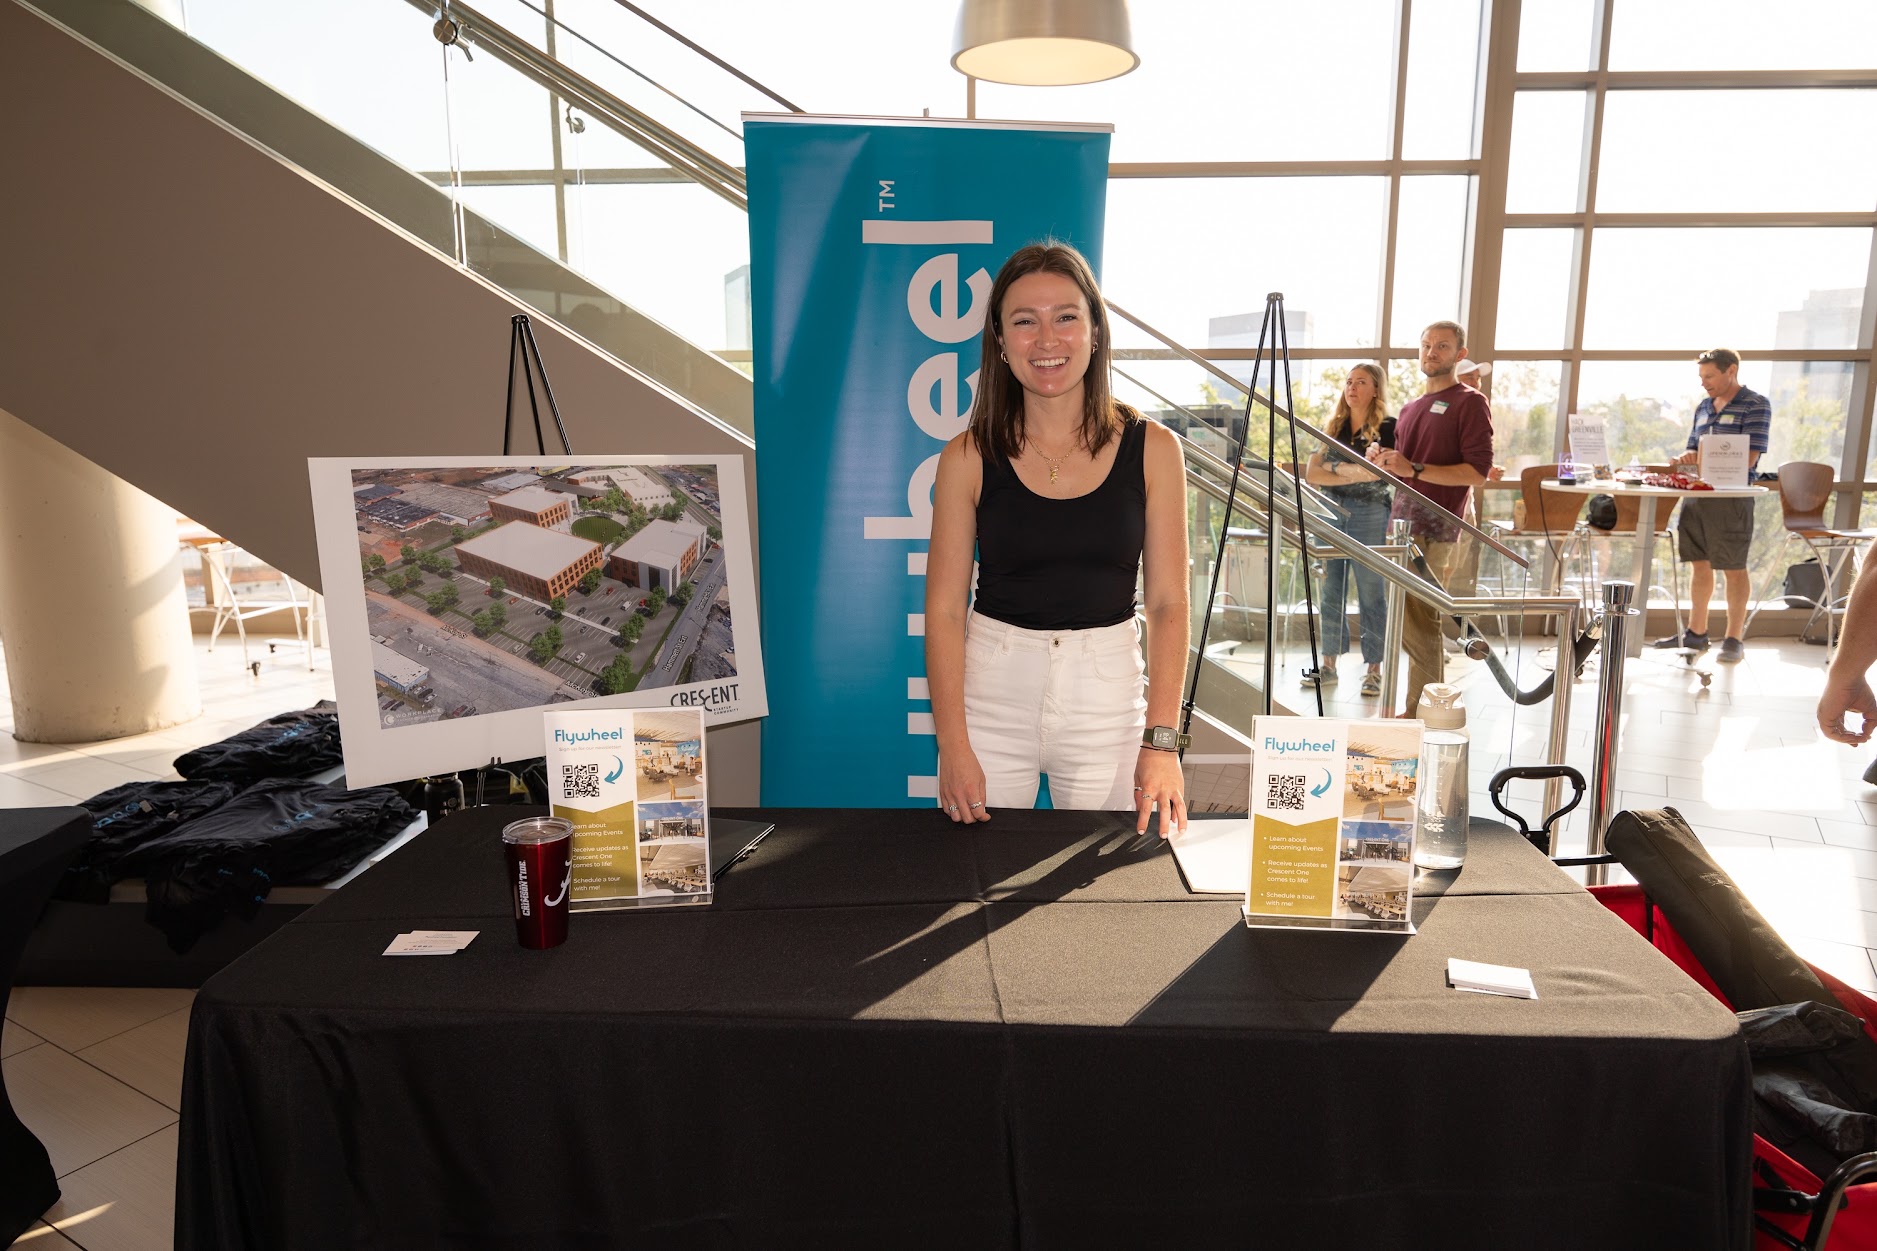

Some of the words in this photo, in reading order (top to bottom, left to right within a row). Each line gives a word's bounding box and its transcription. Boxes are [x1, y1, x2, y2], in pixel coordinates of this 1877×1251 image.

[670, 683, 739, 712] CRESCENT
[554, 727, 623, 745] Flywheel
[1264, 736, 1336, 754] Flywheel
[1268, 844, 1302, 852] upcoming
[518, 860, 528, 880] TIDE
[520, 880, 530, 917] CRIMSON
[1266, 891, 1296, 899] Schedule
